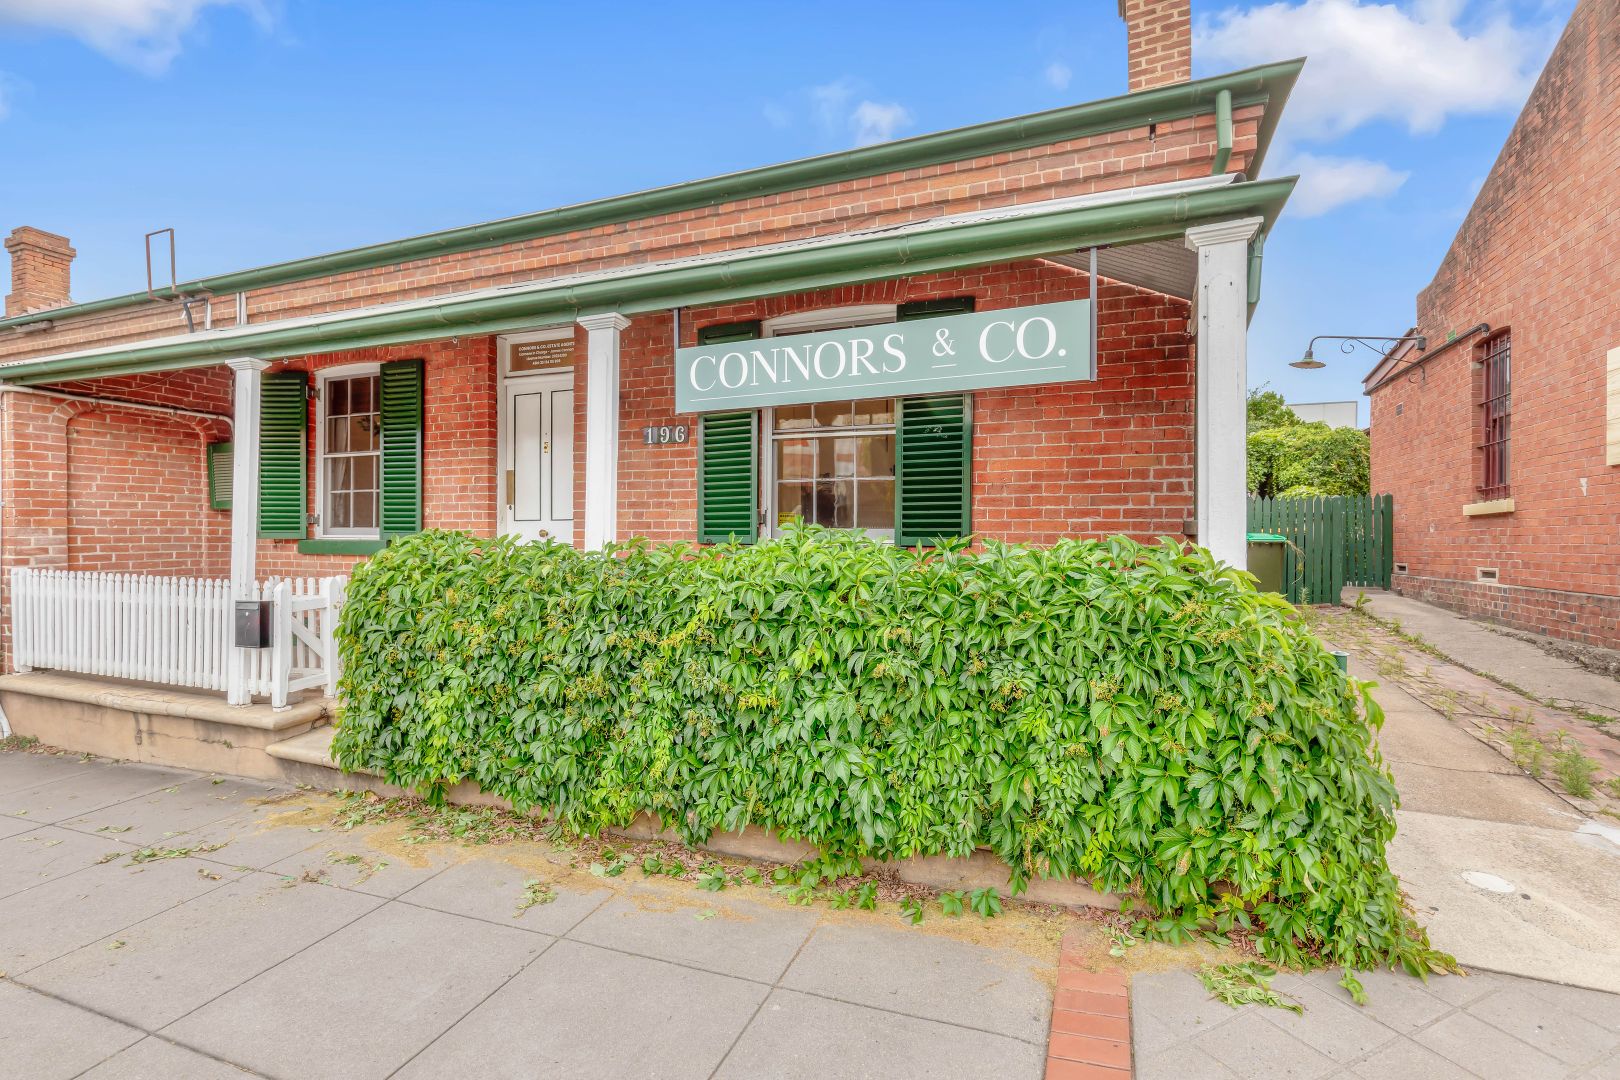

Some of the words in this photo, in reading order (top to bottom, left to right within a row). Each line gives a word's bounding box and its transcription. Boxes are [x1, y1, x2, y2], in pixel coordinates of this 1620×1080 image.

[689, 332, 907, 391] CONNORS
[932, 327, 957, 357] &
[979, 317, 1067, 363] CO.
[646, 425, 686, 445] 196
